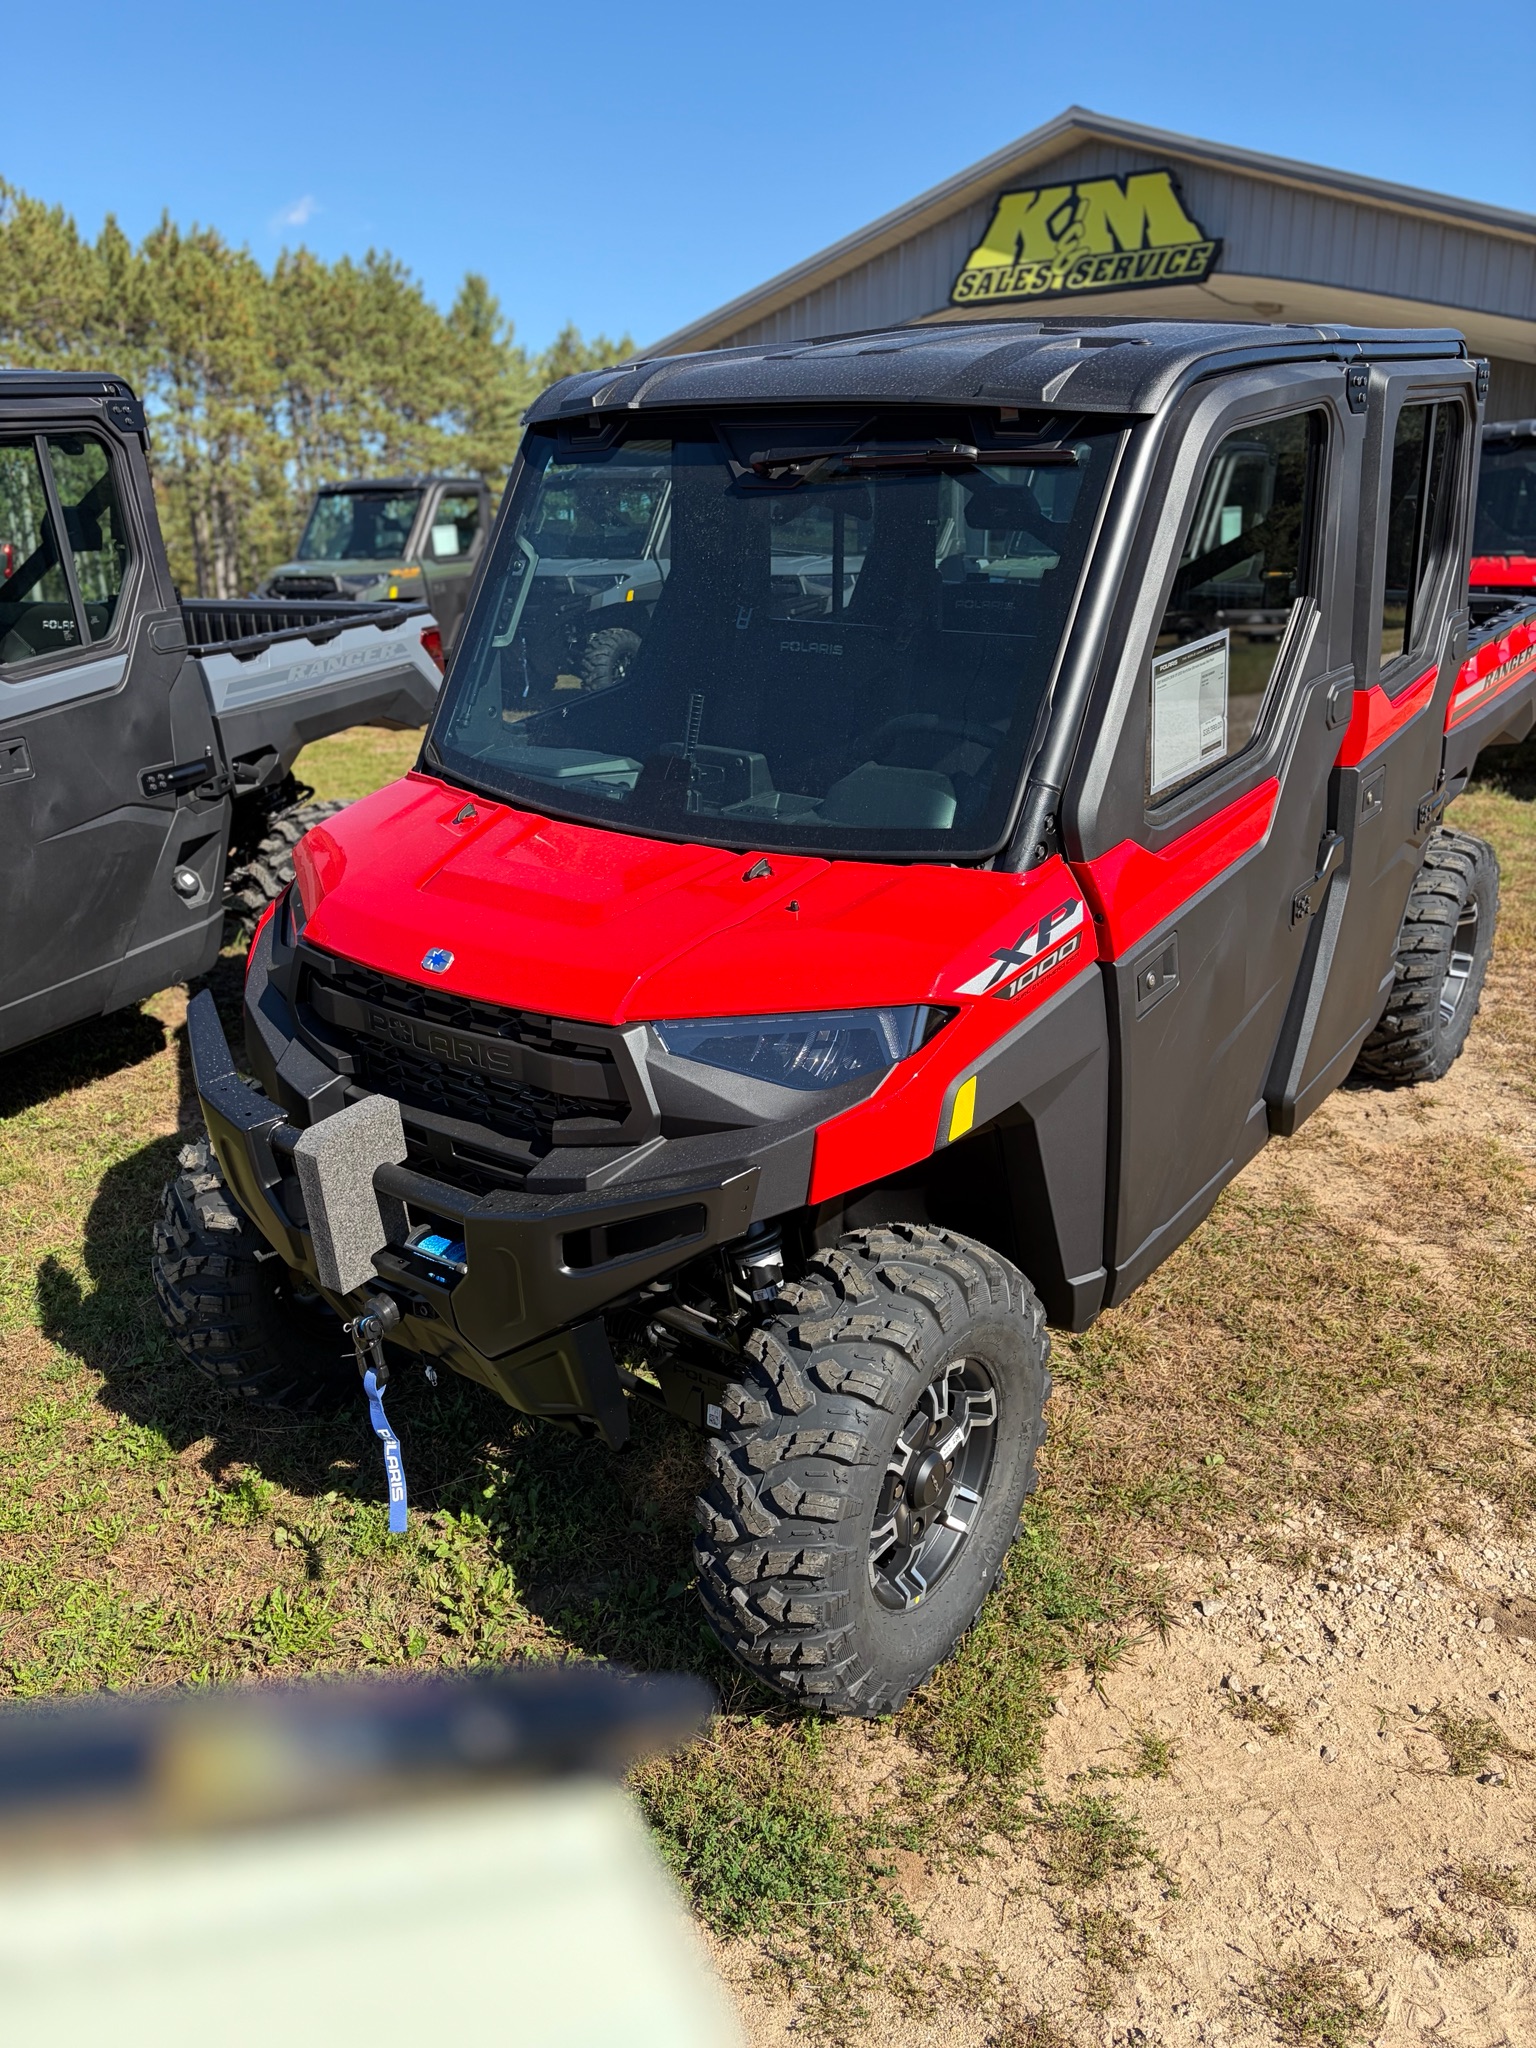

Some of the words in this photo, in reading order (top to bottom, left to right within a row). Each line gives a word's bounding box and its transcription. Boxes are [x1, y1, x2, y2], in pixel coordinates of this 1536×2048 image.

[965, 171, 1204, 275] K&M
[953, 264, 1051, 301] SALES
[1065, 242, 1215, 291] SERVICE
[286, 643, 398, 683] RANGER
[780, 641, 843, 656] POLARIS
[1483, 643, 1533, 691] RANGER
[982, 897, 1079, 992] XP
[1009, 936, 1078, 998] 1000
[368, 1008, 514, 1076] POLARIS
[672, 1363, 728, 1391] POLAR
